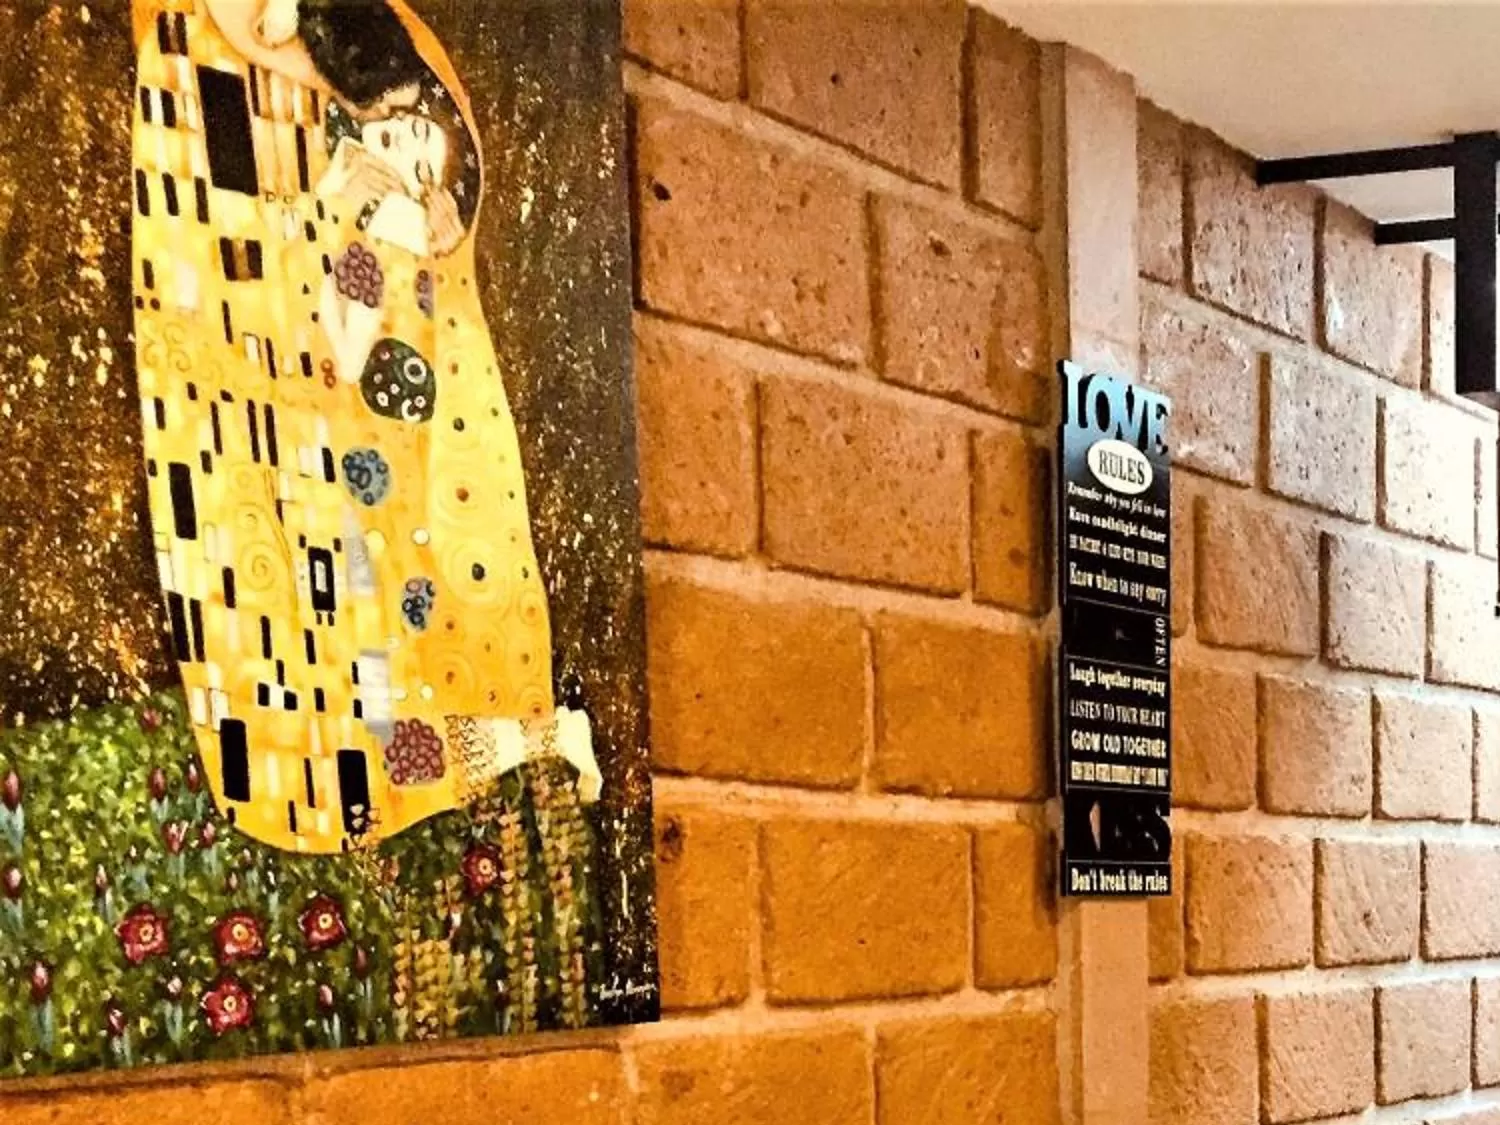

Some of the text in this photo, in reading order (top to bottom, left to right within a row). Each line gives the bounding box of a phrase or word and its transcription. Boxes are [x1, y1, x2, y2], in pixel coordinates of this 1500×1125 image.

[1063, 359, 1171, 458] LOVE
[1098, 448, 1146, 486] RULES
[1069, 561, 1094, 588] Know
[1095, 569, 1118, 594] when
[1119, 575, 1128, 596] to
[1129, 582, 1145, 604] say
[1154, 616, 1168, 668] OFTEN
[1069, 661, 1097, 688] Laugh
[1097, 667, 1131, 691] together
[1070, 699, 1166, 729] LISTEN TO YOUR HEART
[1071, 728, 1167, 759] GROW OLD TOGETHER
[1070, 867, 1169, 893] Don't break the rules
